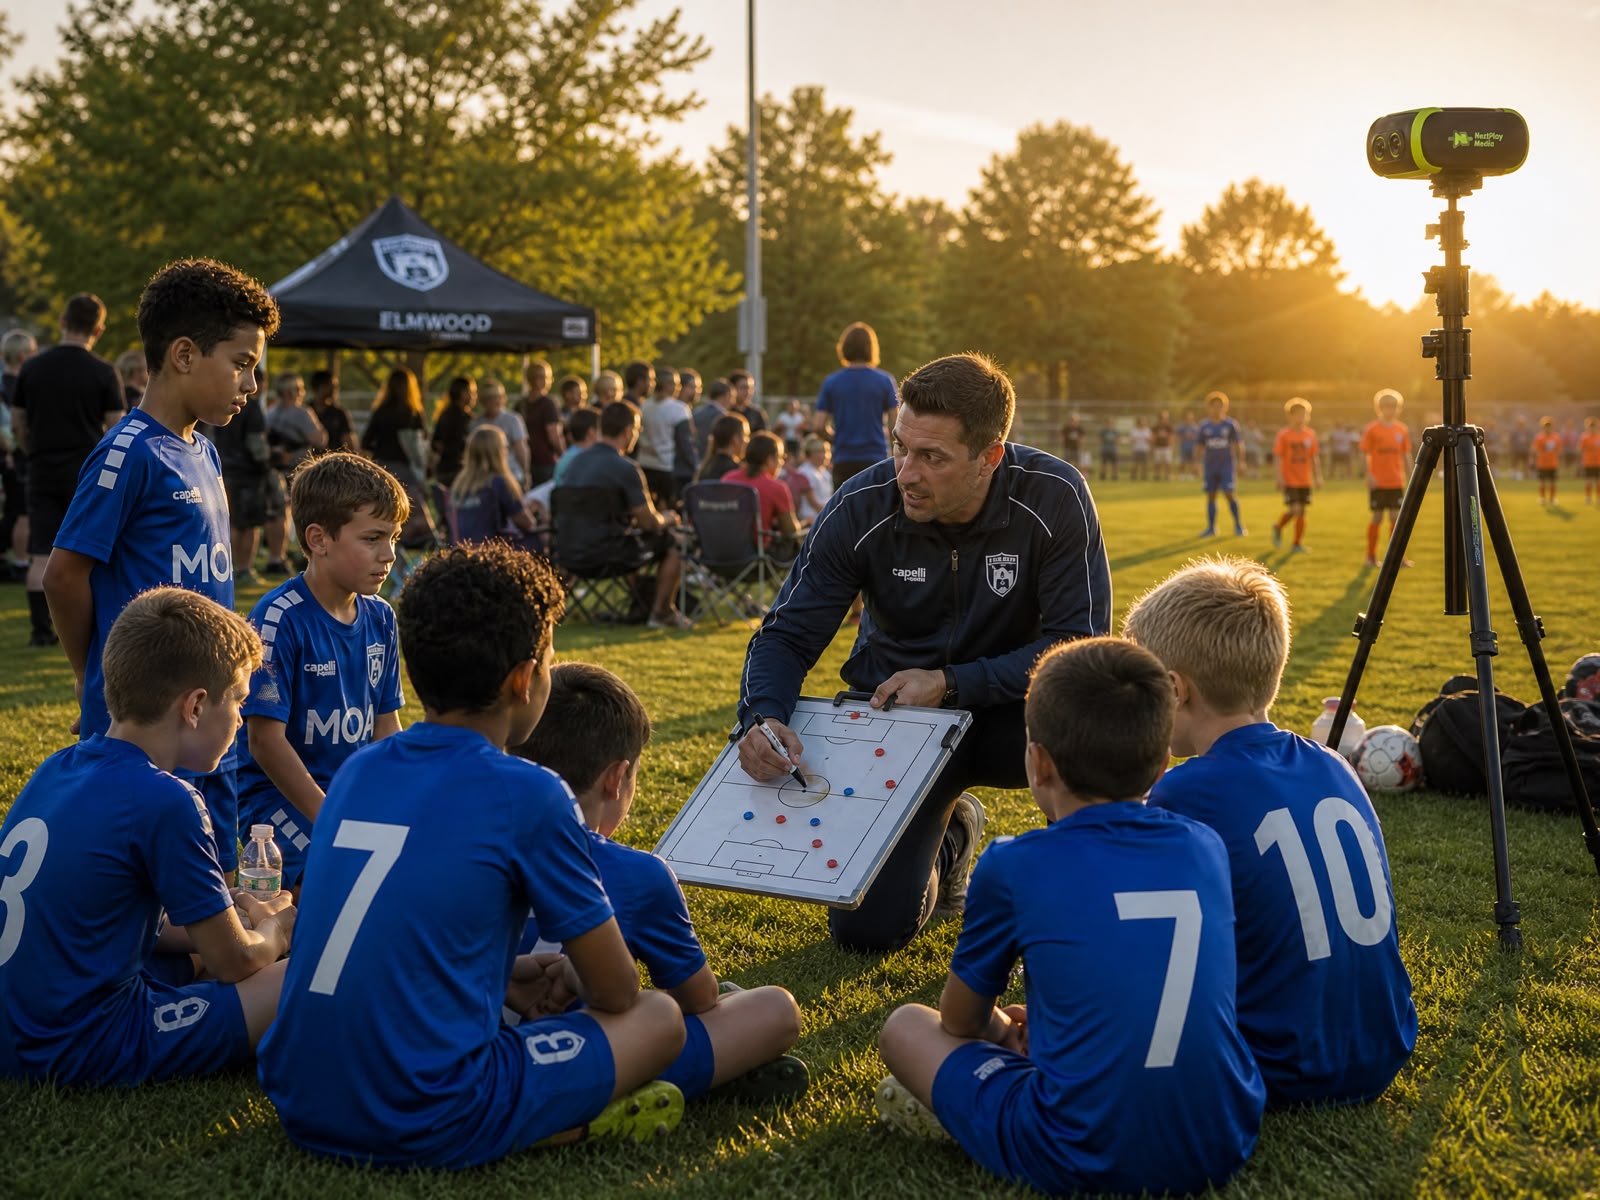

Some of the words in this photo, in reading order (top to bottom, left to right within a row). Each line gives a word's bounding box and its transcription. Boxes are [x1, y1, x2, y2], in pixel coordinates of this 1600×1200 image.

[379, 311, 492, 332] ELMWOOD
[892, 567, 926, 582] capelli
[304, 660, 336, 676] capelli
[304, 703, 375, 745] MOA
[0, 817, 49, 966] 3
[309, 820, 409, 995] 7
[1253, 796, 1391, 961] 10
[1113, 889, 1202, 1068] 7
